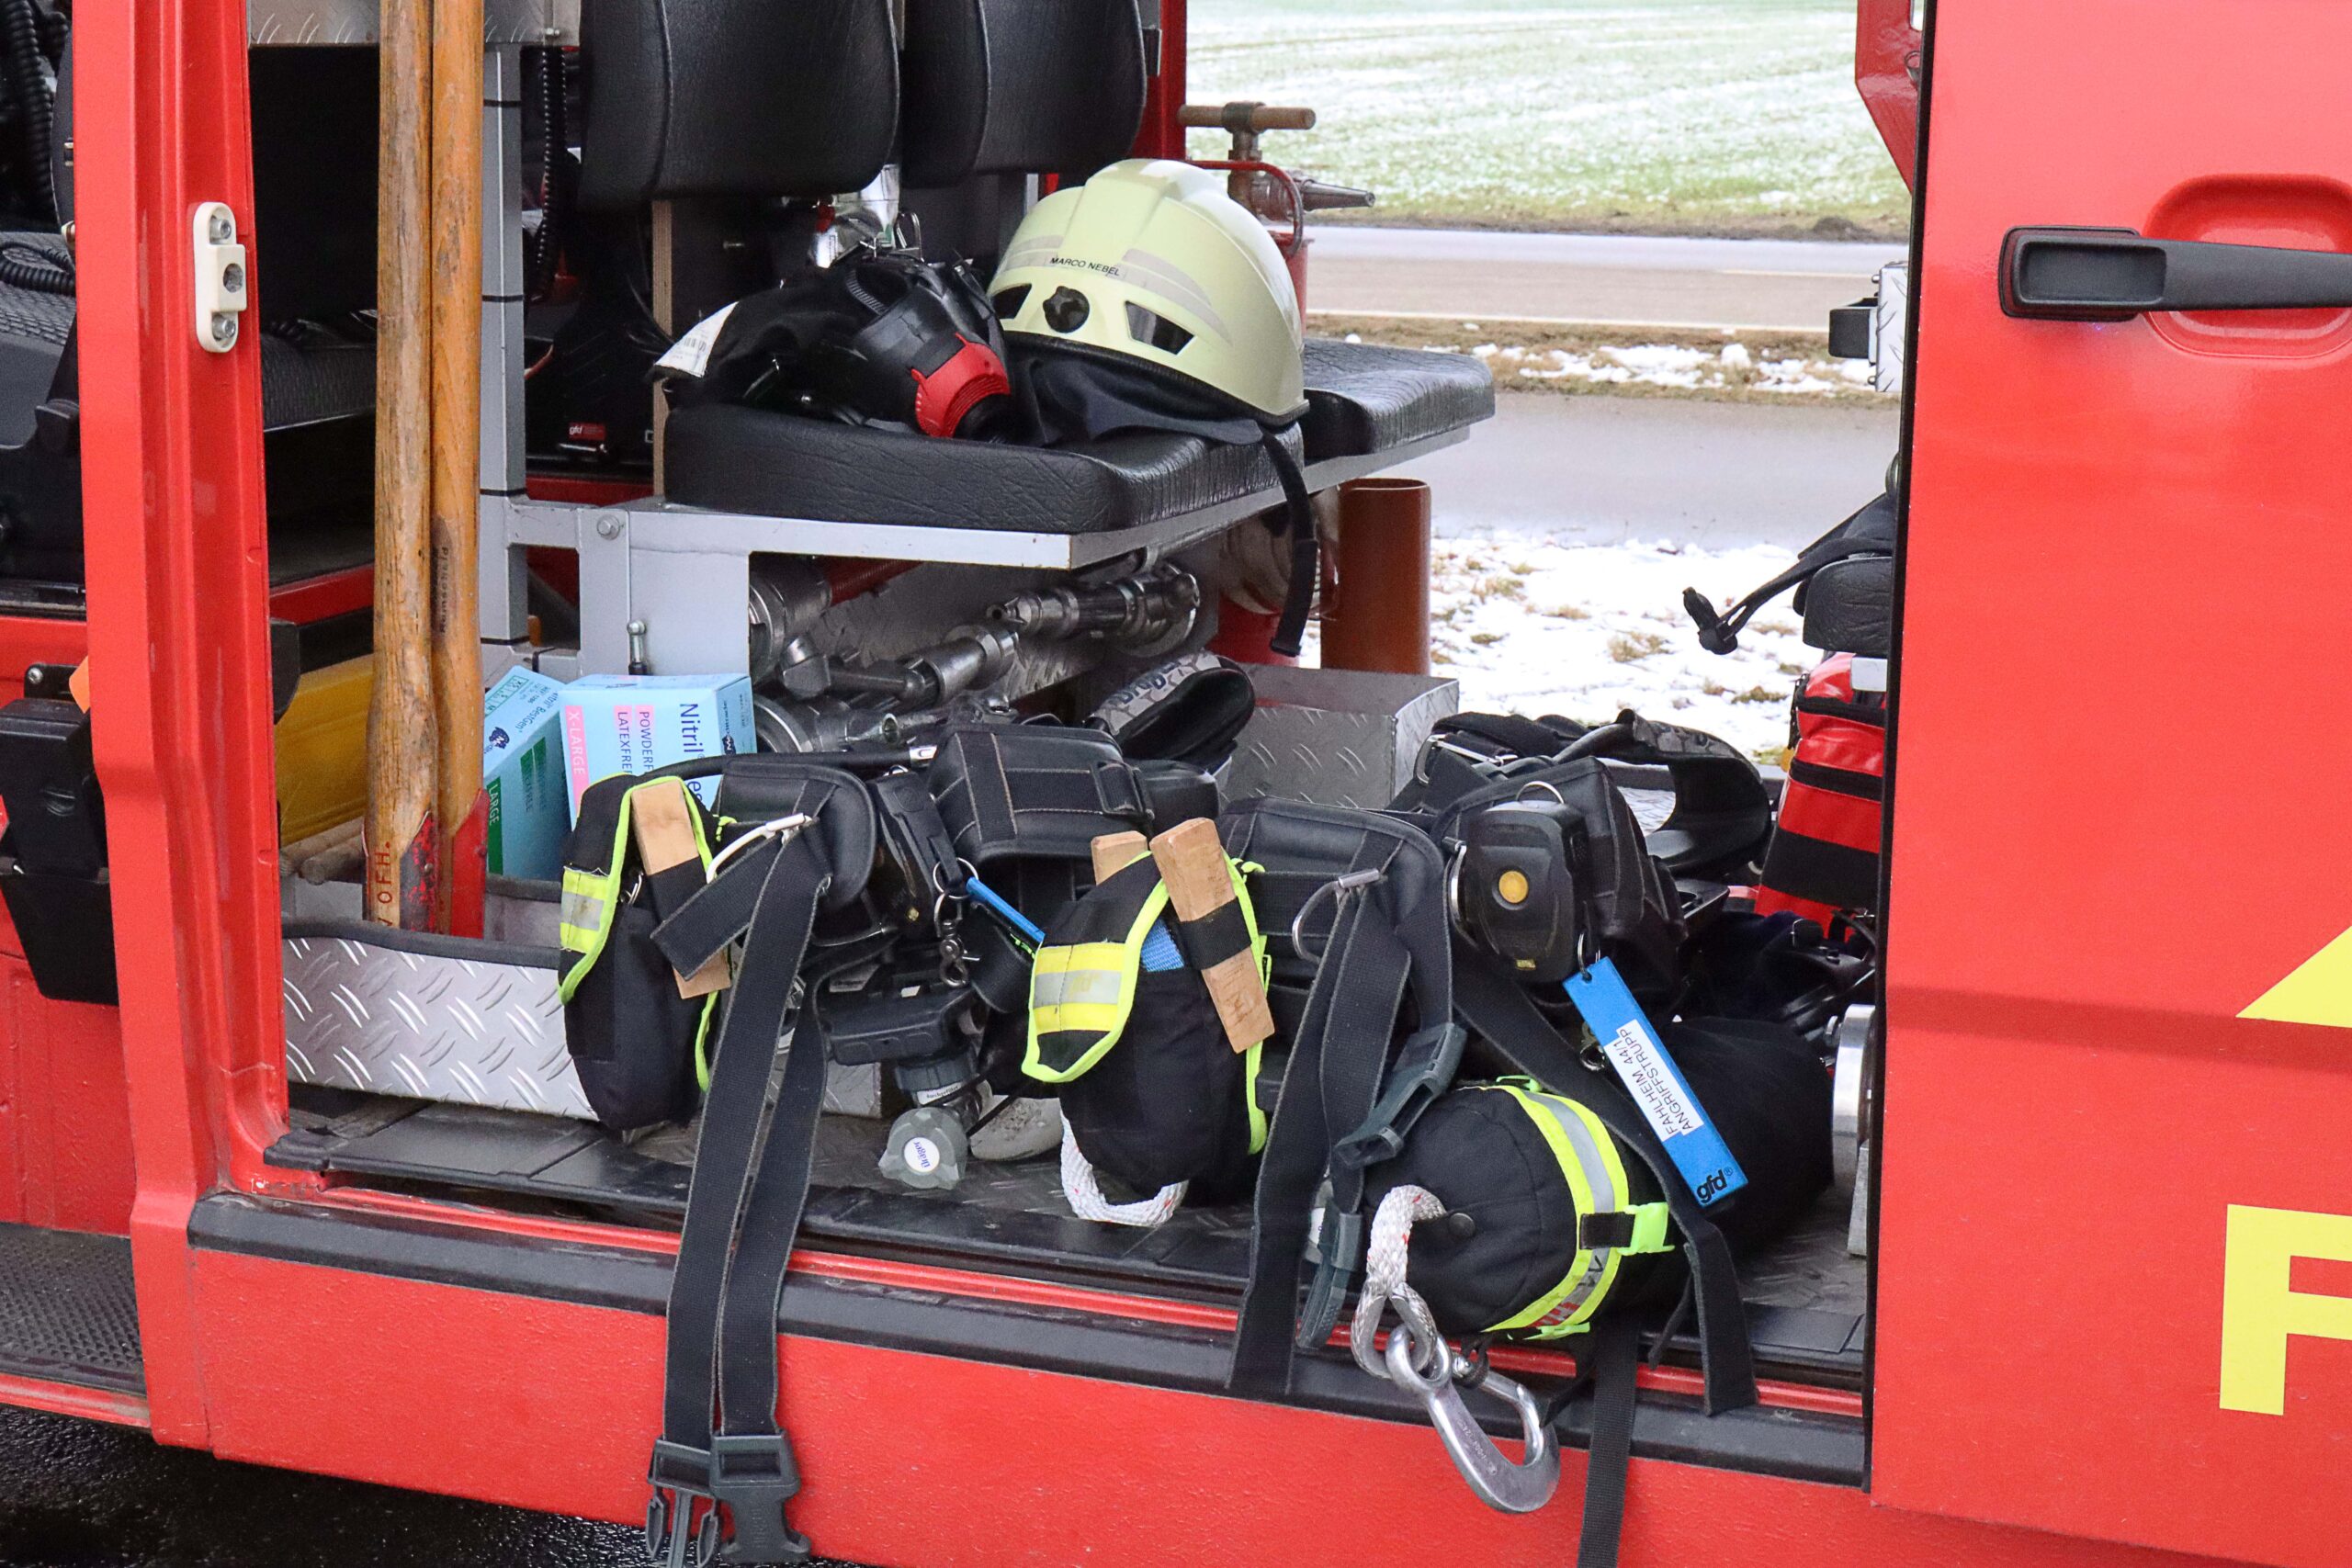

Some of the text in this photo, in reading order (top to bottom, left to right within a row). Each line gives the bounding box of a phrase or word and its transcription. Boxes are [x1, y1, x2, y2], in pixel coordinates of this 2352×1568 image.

[1049, 257, 1120, 276] MARCO NEBEL
[568, 711, 585, 775] X-LARGE
[488, 784, 500, 827] LARGE
[1612, 1038, 1678, 1135] FAHLHEIM 44/1
[1619, 1028, 1694, 1131] ANGRIFFSTRUPP
